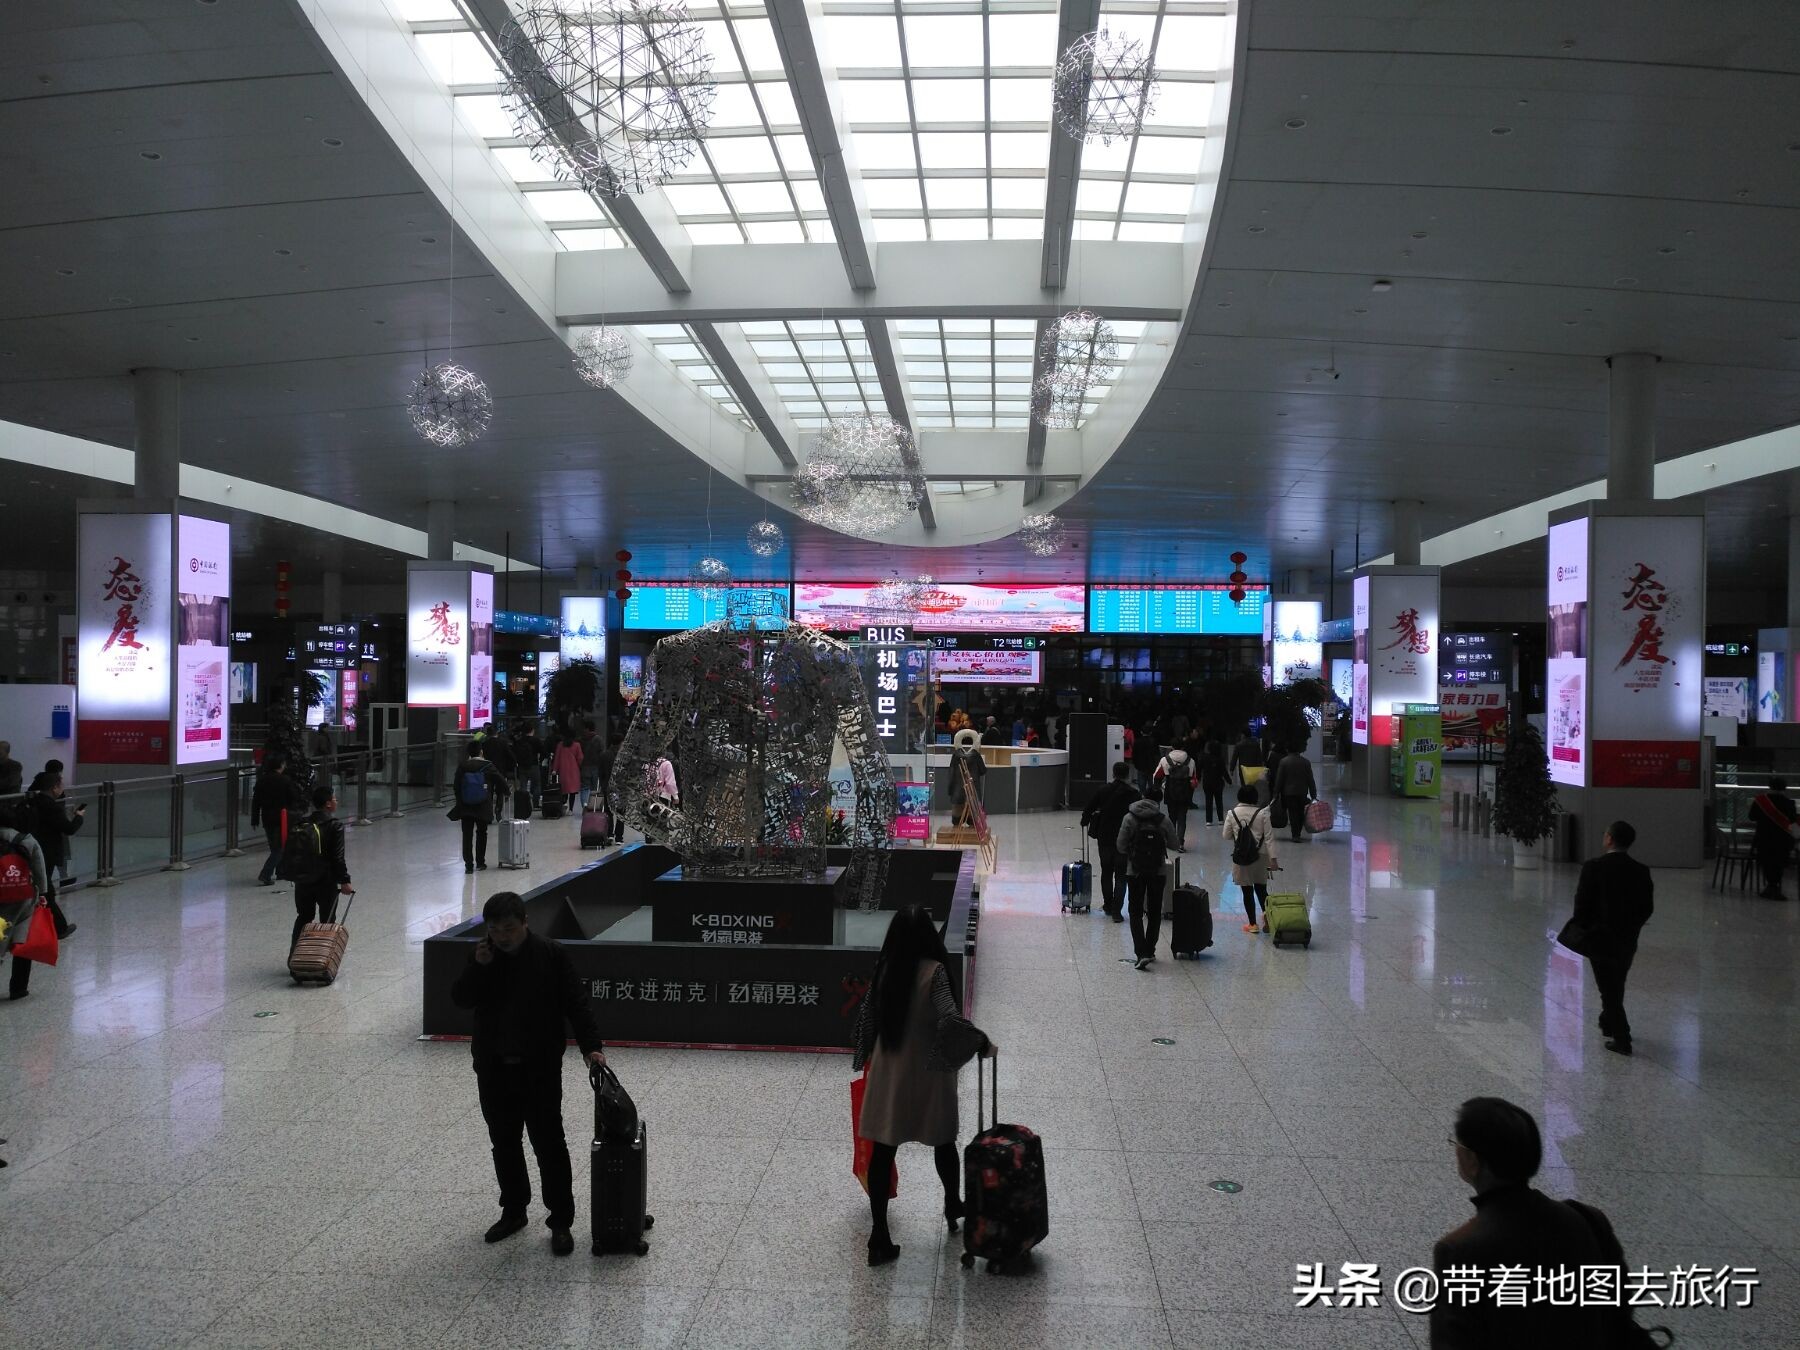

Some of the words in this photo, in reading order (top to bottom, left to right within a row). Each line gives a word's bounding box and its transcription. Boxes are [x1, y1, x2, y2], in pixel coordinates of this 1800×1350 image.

[98, 556, 144, 655] 态度
[1615, 562, 1670, 672] 态度
[413, 601, 461, 645] 梦想
[867, 627, 905, 641] BUS
[1378, 608, 1431, 654] 梦想
[993, 639, 1005, 647] T2
[876, 649, 899, 737] 机场巴士
[1440, 693, 1500, 706] 家有力量
[692, 914, 774, 928] K-BOXING
[701, 930, 763, 944] 劲霸男装
[582, 978, 707, 1003] 断改进茄克
[728, 982, 820, 1006] 劲霸男装
